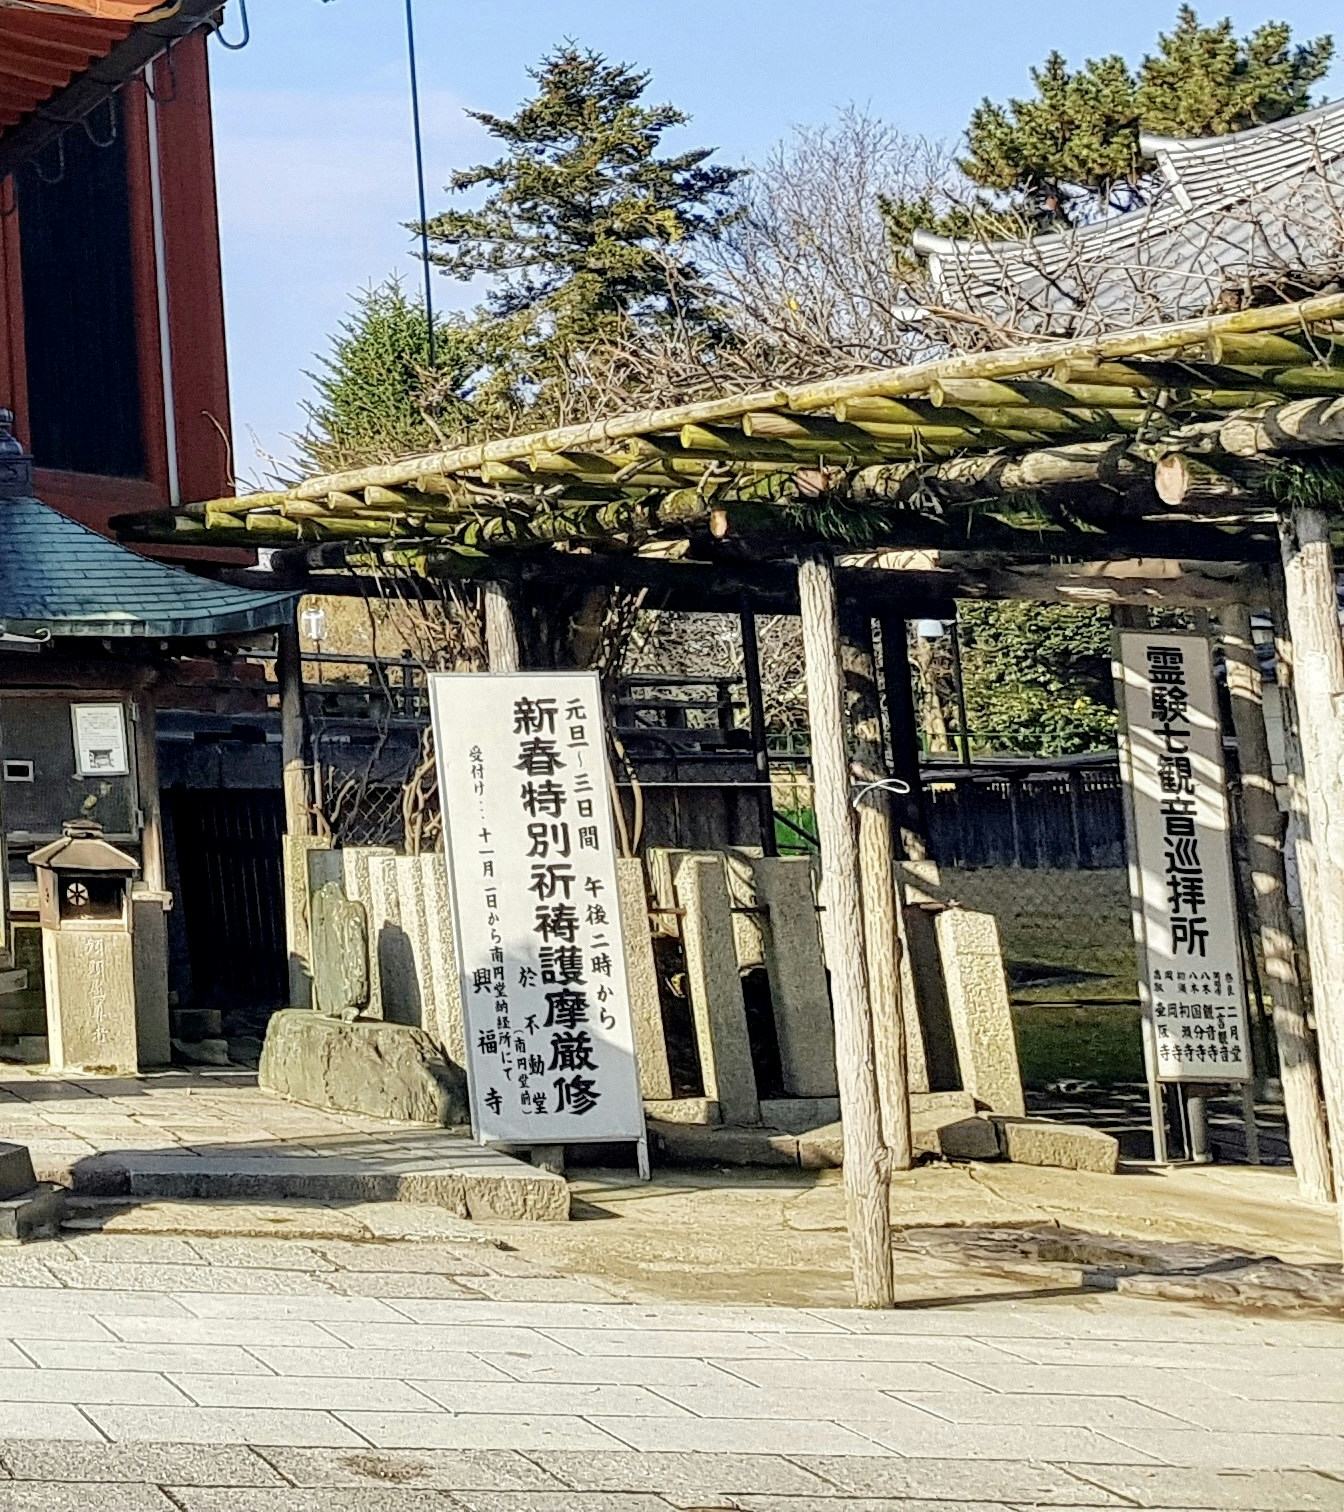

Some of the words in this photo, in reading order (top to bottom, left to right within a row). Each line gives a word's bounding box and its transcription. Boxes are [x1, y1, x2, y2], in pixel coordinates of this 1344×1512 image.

[1146, 645, 1209, 958] 霊験七観音巡拝所
[584, 876, 617, 1031] 午後二時から
[473, 966, 503, 1116] 興福寺
